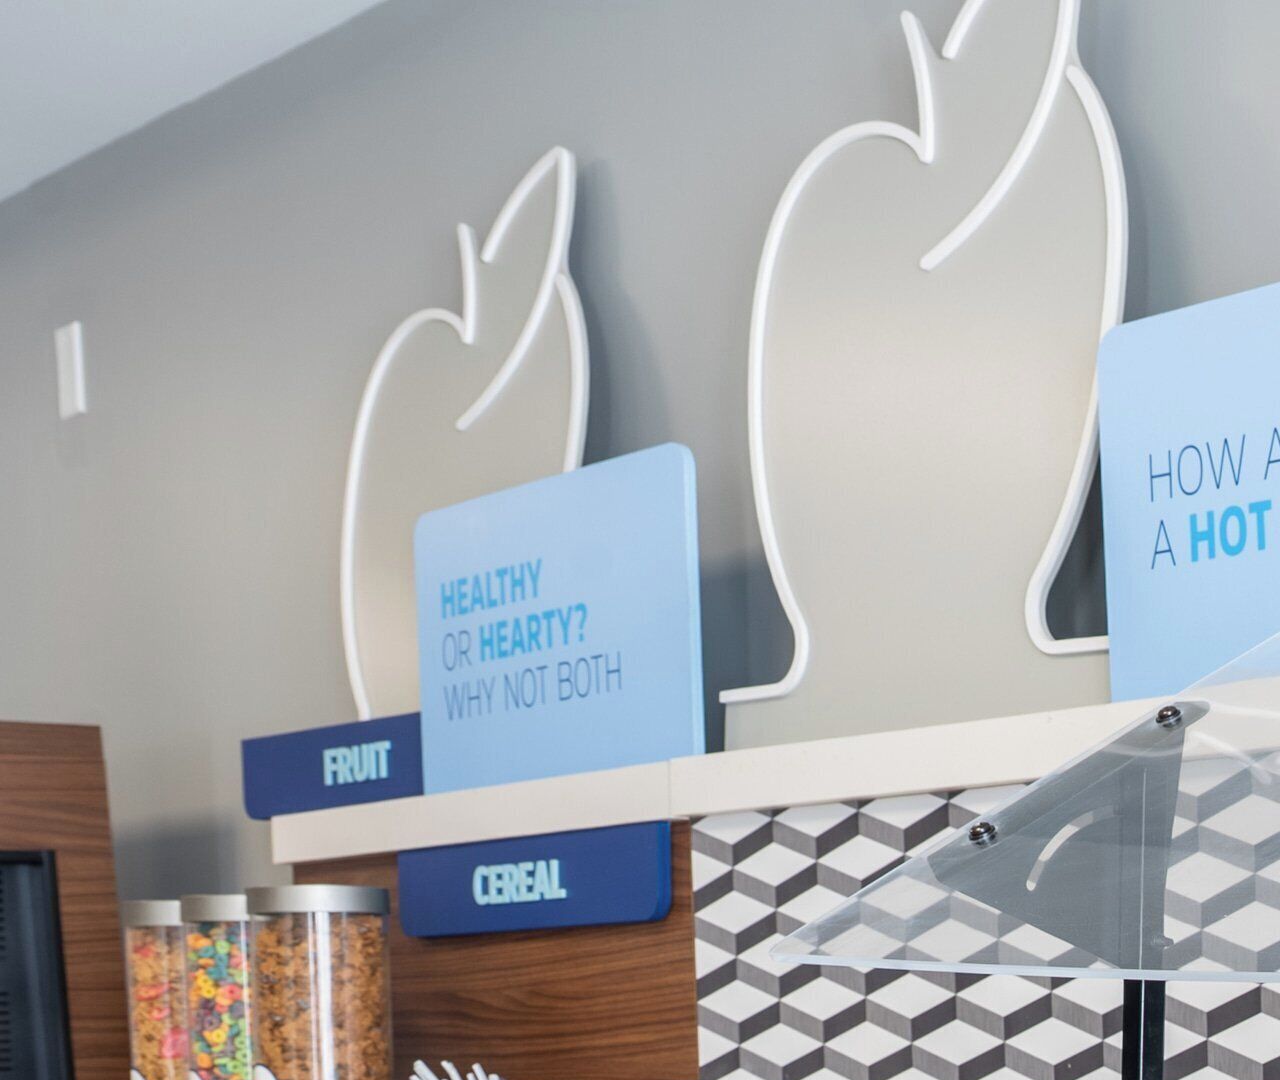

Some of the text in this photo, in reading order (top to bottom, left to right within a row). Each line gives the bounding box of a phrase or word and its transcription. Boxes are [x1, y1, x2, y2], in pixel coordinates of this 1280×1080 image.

[1149, 433, 1246, 503] HOW
[1151, 519, 1177, 570] A
[1188, 499, 1273, 563] HOT
[440, 558, 543, 620] HEALTHY
[441, 602, 589, 672] OR HEARTY?
[443, 651, 623, 721] WHY NOT BOTH
[323, 740, 392, 787] FRUIT
[472, 858, 568, 906] CEREAL
